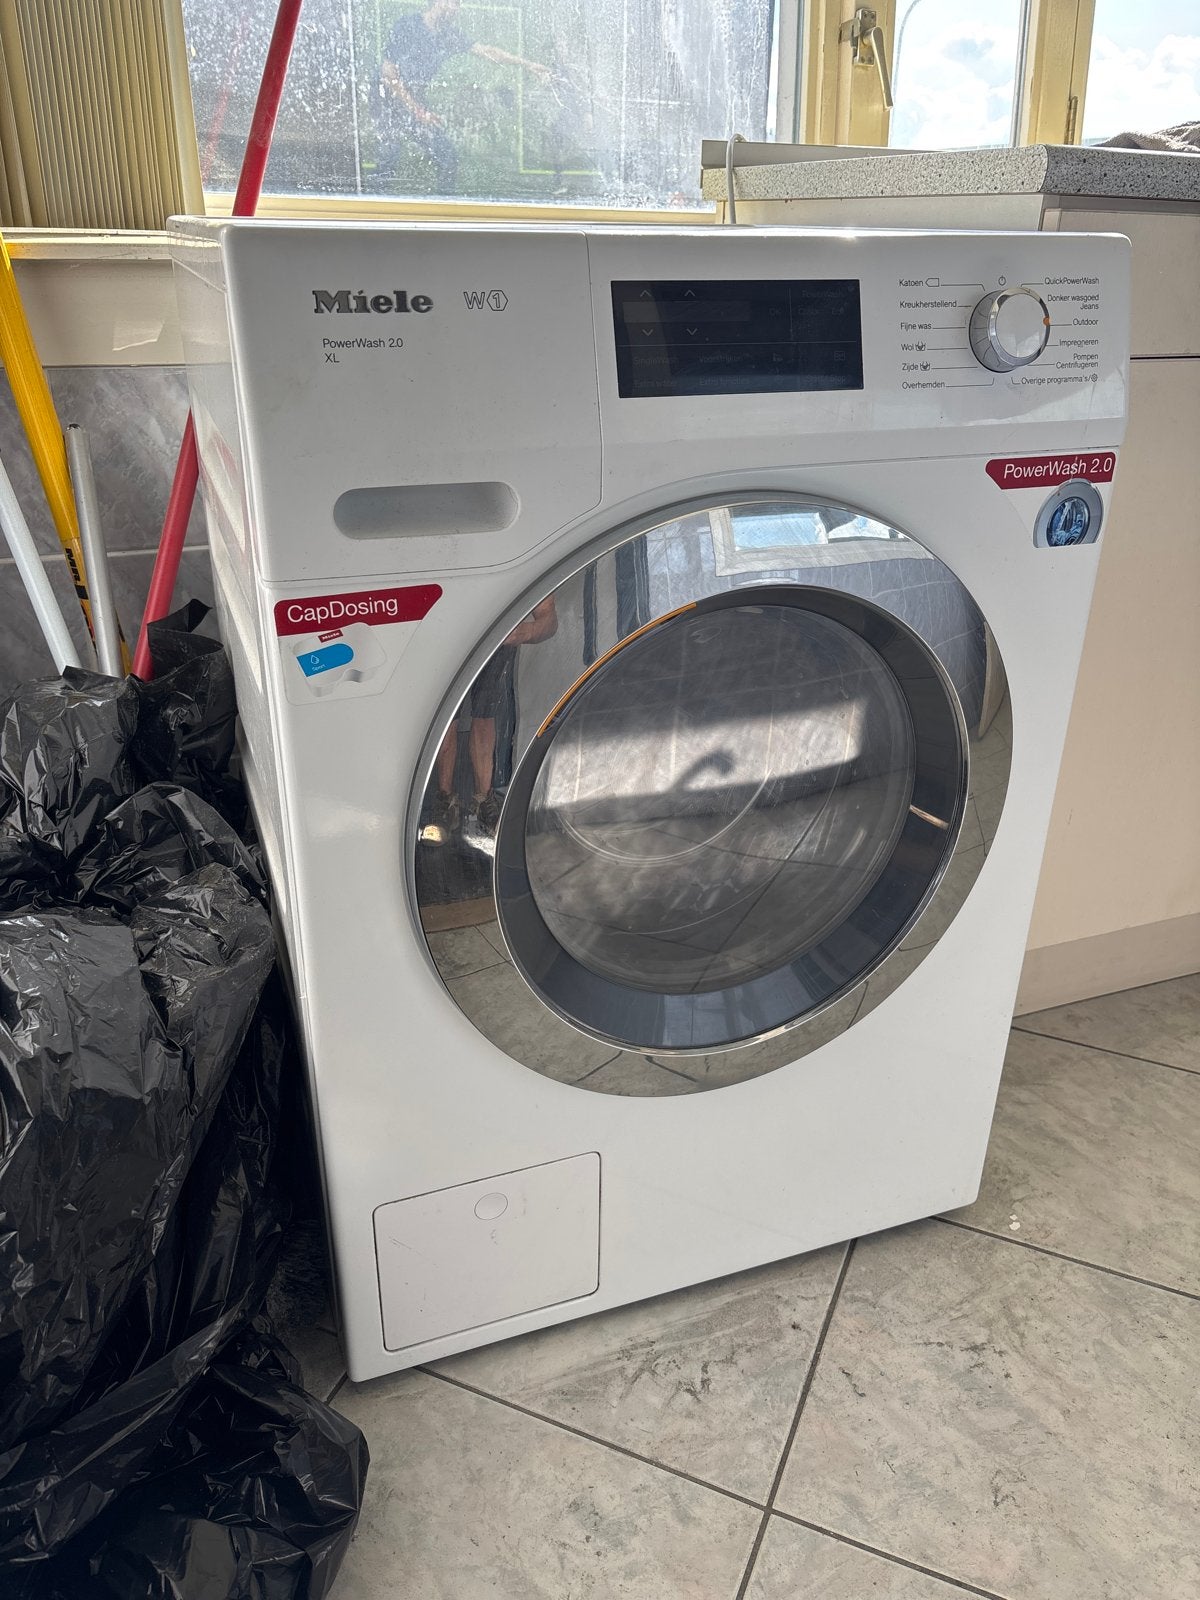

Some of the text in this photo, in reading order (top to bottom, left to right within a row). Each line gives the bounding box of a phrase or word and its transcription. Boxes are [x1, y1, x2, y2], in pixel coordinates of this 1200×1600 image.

[899, 279, 924, 287] Katoen
[1044, 277, 1100, 286] QuickPowerWash
[312, 289, 434, 314] Miele
[1047, 294, 1100, 303] Donker wasgoed
[899, 300, 957, 309] Kreukherstellend
[900, 322, 917, 331] Fijne
[1072, 318, 1099, 326] Outdoor
[322, 337, 404, 348] PowerWash 2.0
[900, 343, 915, 351] Wol
[1059, 338, 1099, 348] Impregneren
[324, 353, 340, 363] XL
[1073, 353, 1099, 361] Pompen
[901, 363, 919, 372] Zijde
[1055, 360, 1099, 370] Centrifugeren
[901, 380, 946, 390] Overhemden
[1021, 376, 1046, 385] Overige
[1003, 457, 1113, 479] PowerWash 2.0
[286, 596, 398, 624] CapDosing
